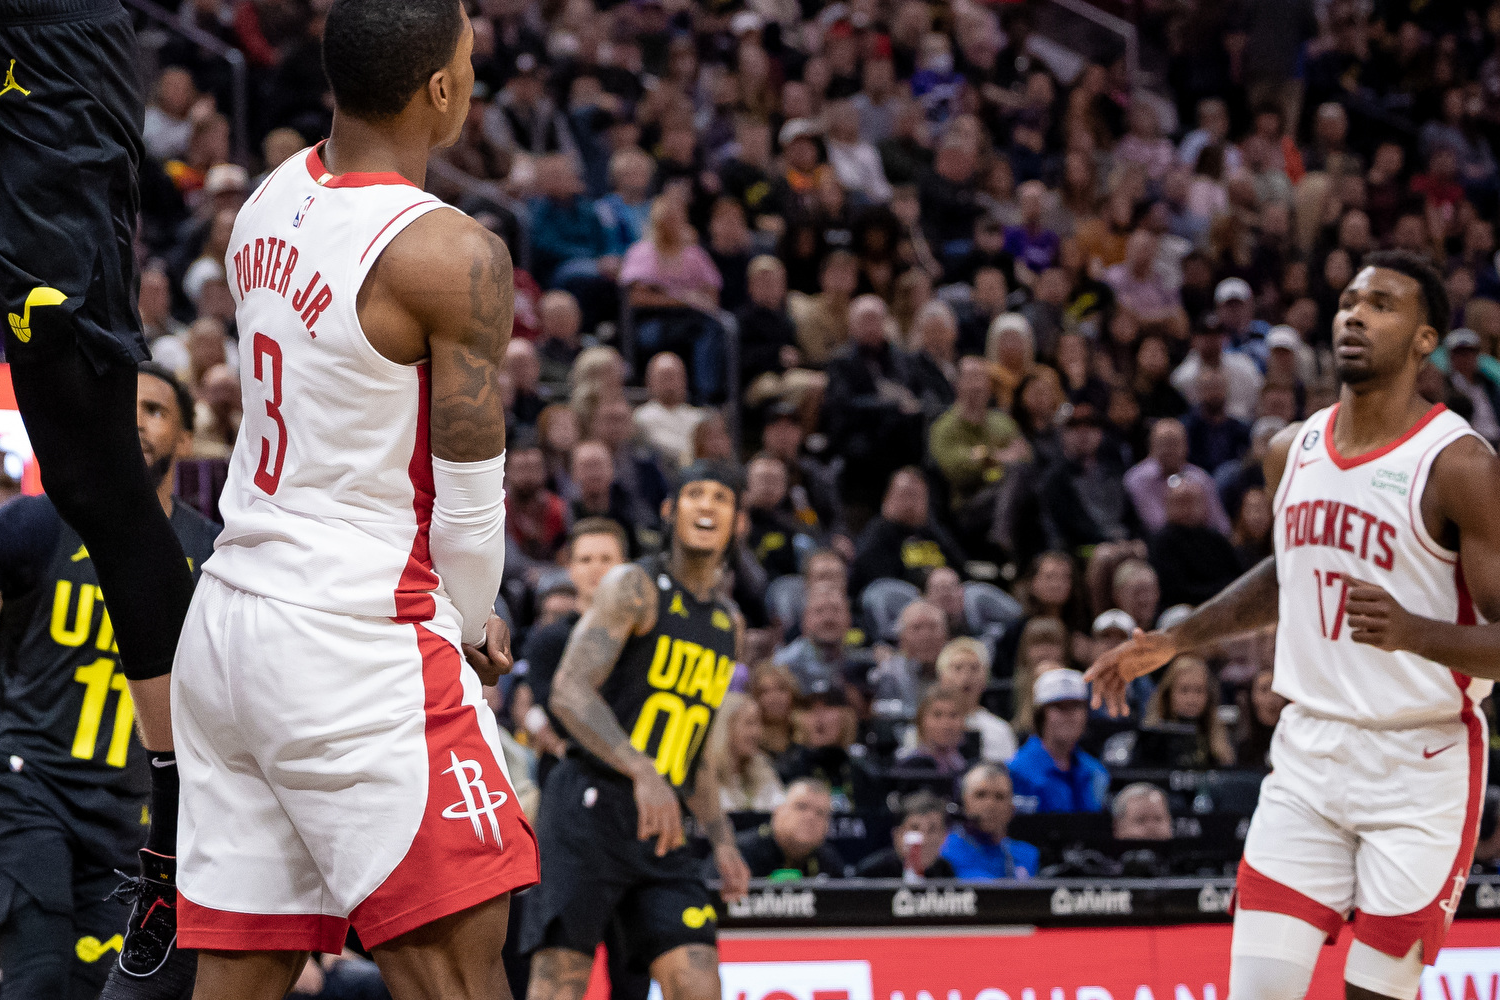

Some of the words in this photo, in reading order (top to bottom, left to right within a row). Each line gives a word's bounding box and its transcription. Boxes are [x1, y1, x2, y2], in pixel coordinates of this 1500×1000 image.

[234, 236, 299, 301] PORTER
[292, 270, 333, 339] JR.
[253, 331, 288, 496] 3
[1285, 499, 1397, 572] ROCKETS
[1313, 568, 1349, 641] 17
[73, 657, 133, 768] 11
[647, 635, 736, 709] UTAH
[630, 691, 710, 787] 00
